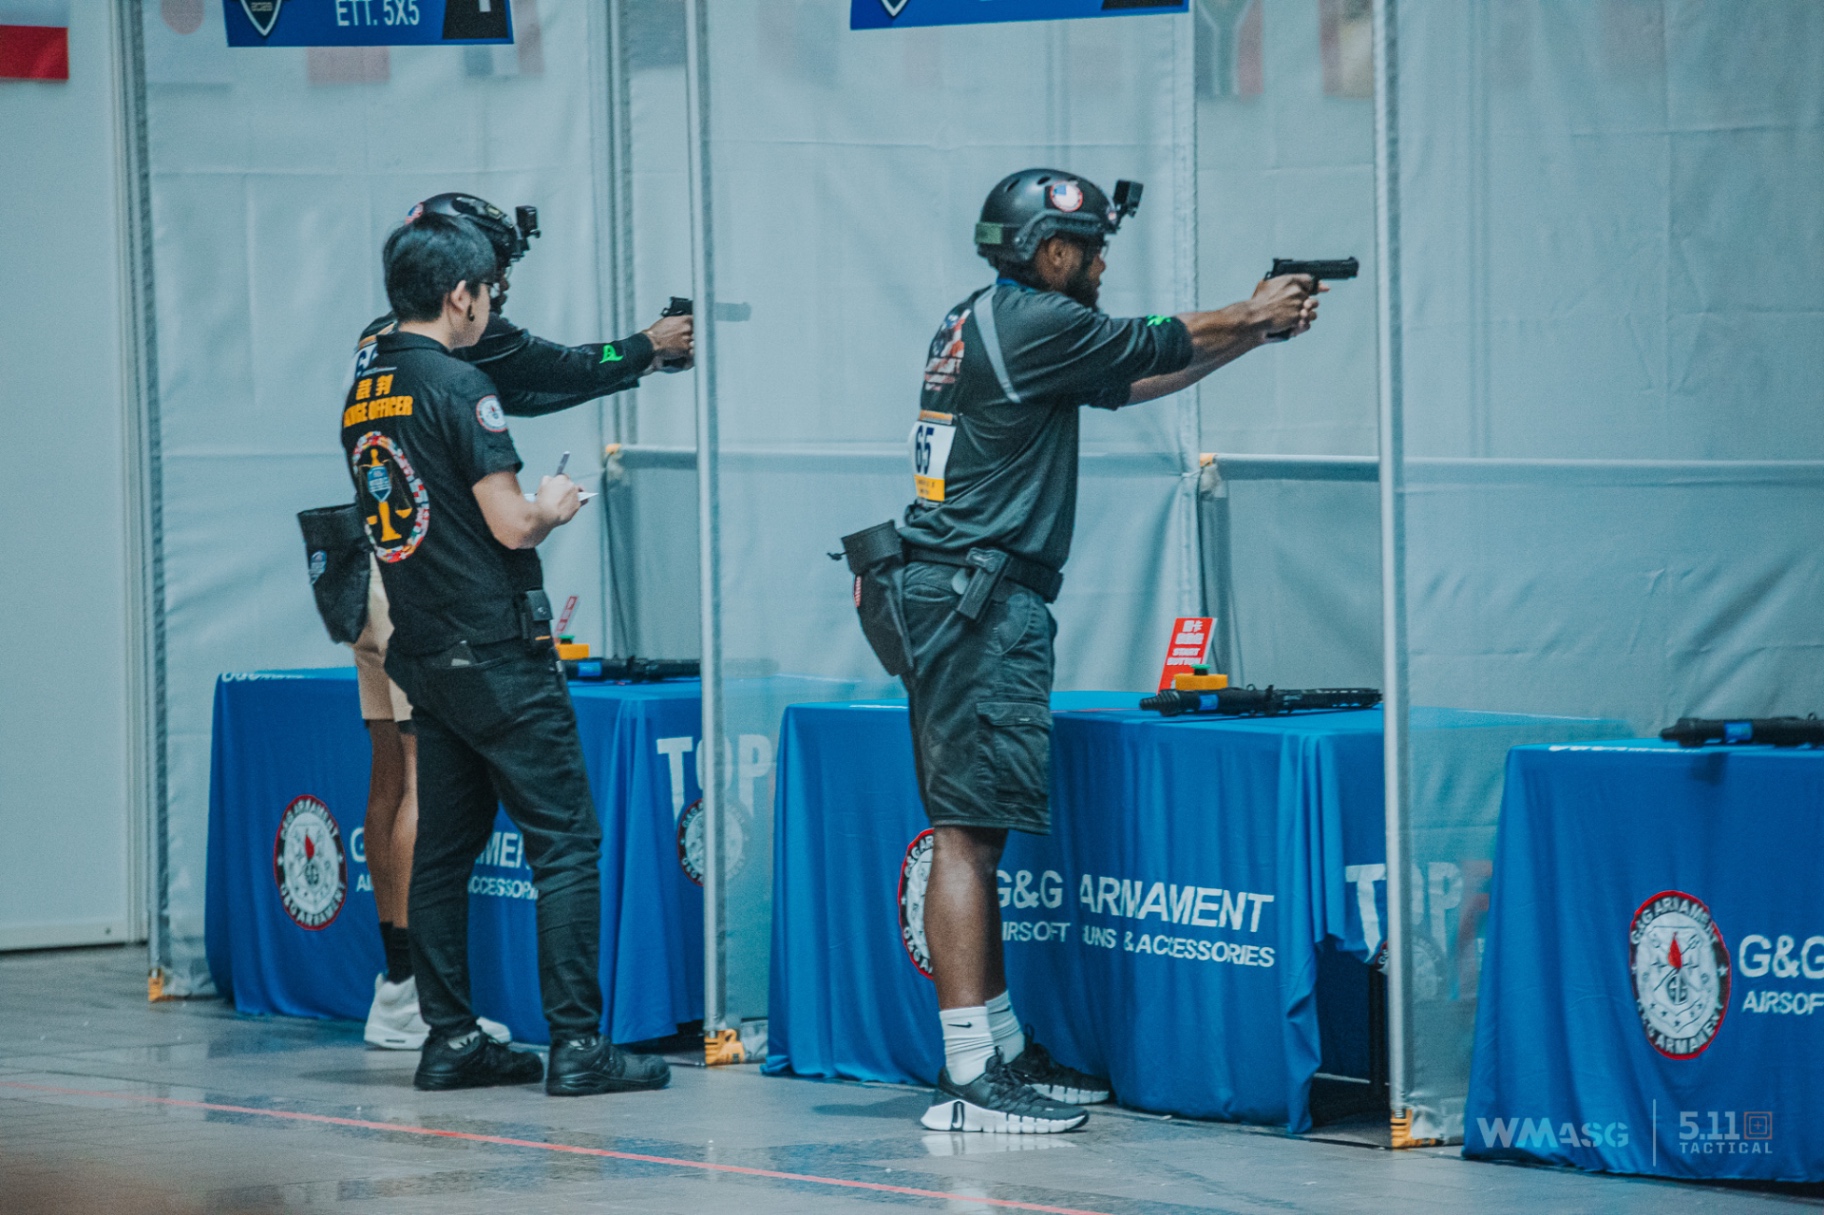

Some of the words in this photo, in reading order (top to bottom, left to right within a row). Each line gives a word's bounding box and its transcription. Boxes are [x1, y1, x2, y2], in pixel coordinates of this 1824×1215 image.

[383, 0, 420, 26] 5X5
[997, 869, 1064, 909] G&G
[1001, 920, 1071, 942] IRSOFT
[1082, 924, 1118, 949] UNS
[1739, 933, 1824, 979] G&G
[1741, 990, 1824, 1015] AIRSOF
